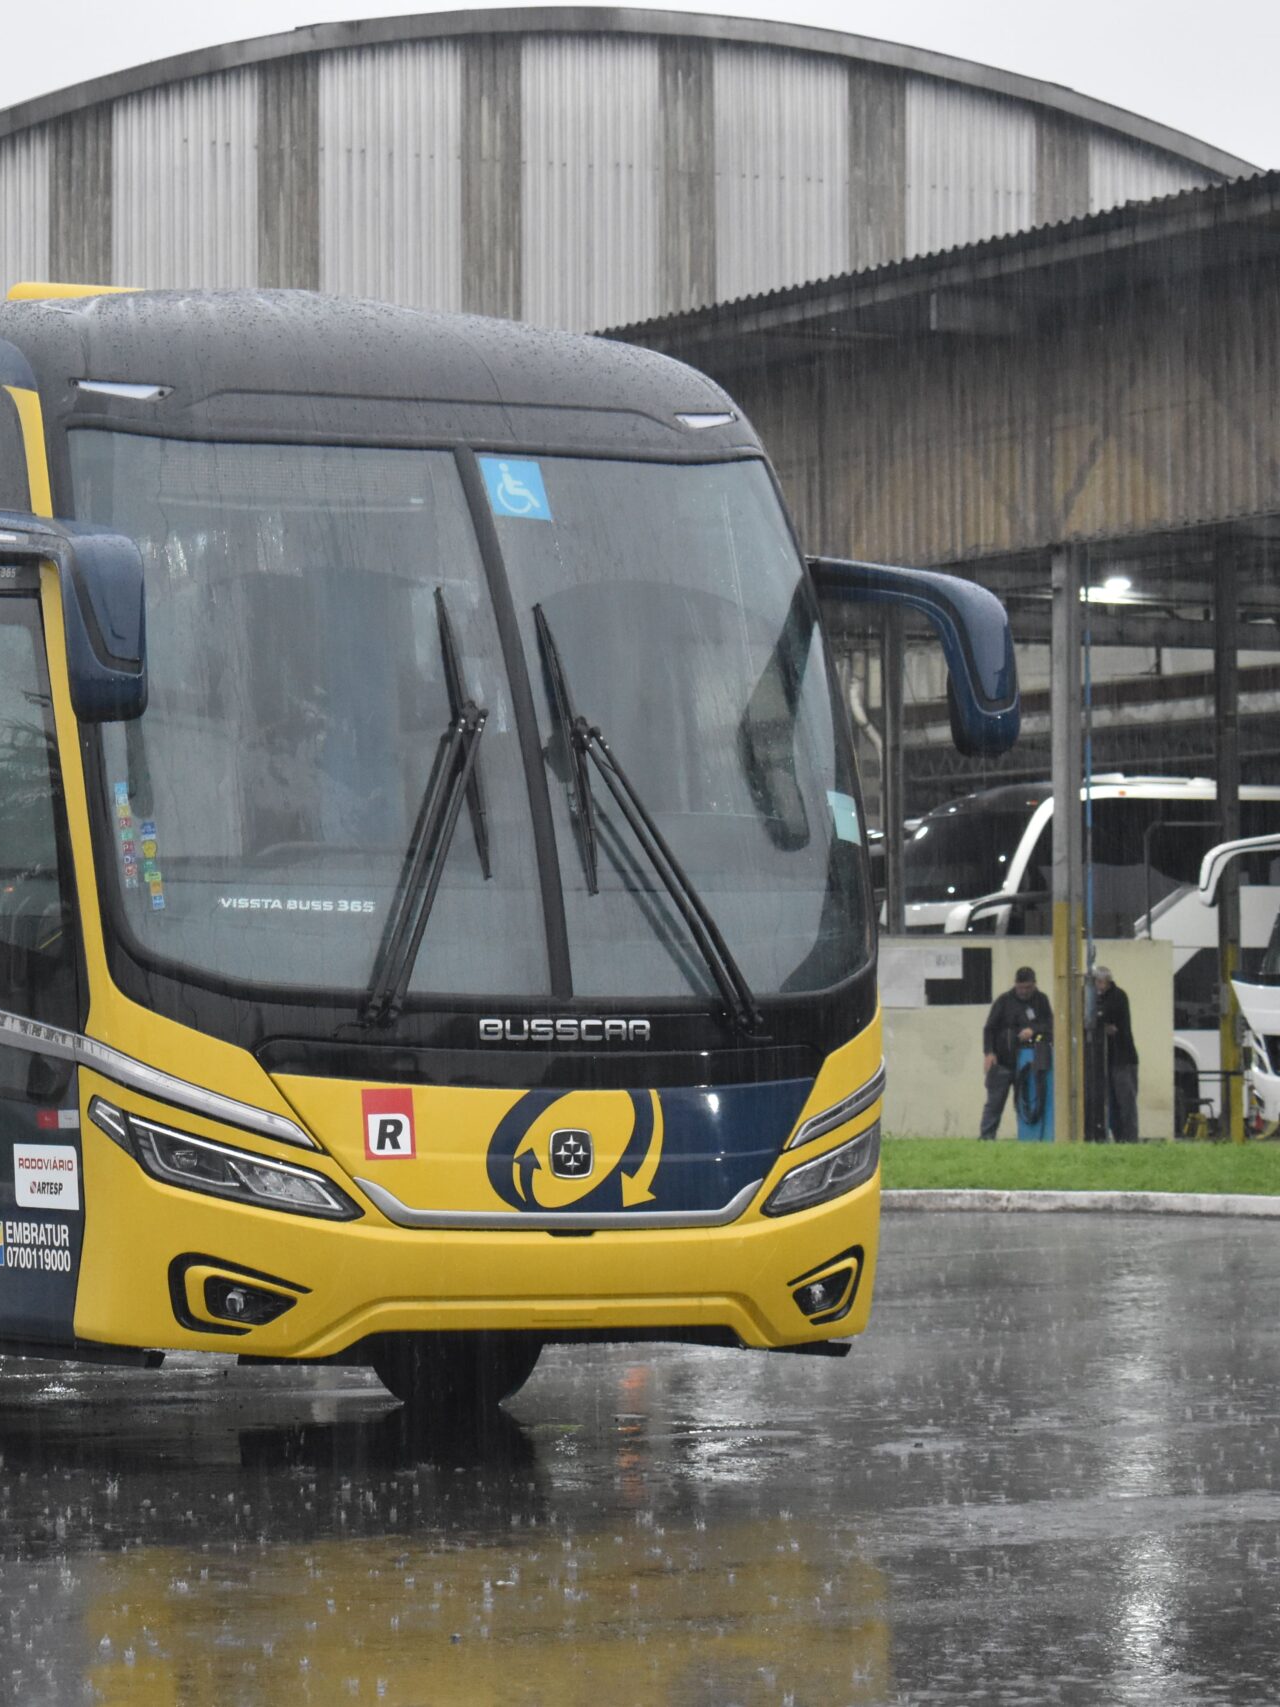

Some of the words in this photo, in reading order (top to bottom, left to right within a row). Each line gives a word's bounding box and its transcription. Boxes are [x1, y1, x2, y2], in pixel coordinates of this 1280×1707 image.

[1, 567, 16, 578] 365
[219, 897, 282, 909] VISSTA
[286, 900, 334, 911] BUSS
[337, 900, 376, 912] 365
[479, 1019, 651, 1041] BUSSCAR
[376, 1119, 403, 1150] R
[18, 1157, 74, 1171] RODOVIÁRIO
[36, 1182, 63, 1195] ARTESP
[5, 1221, 70, 1247] EMBRATUR
[6, 1246, 71, 1272] 0700119000
